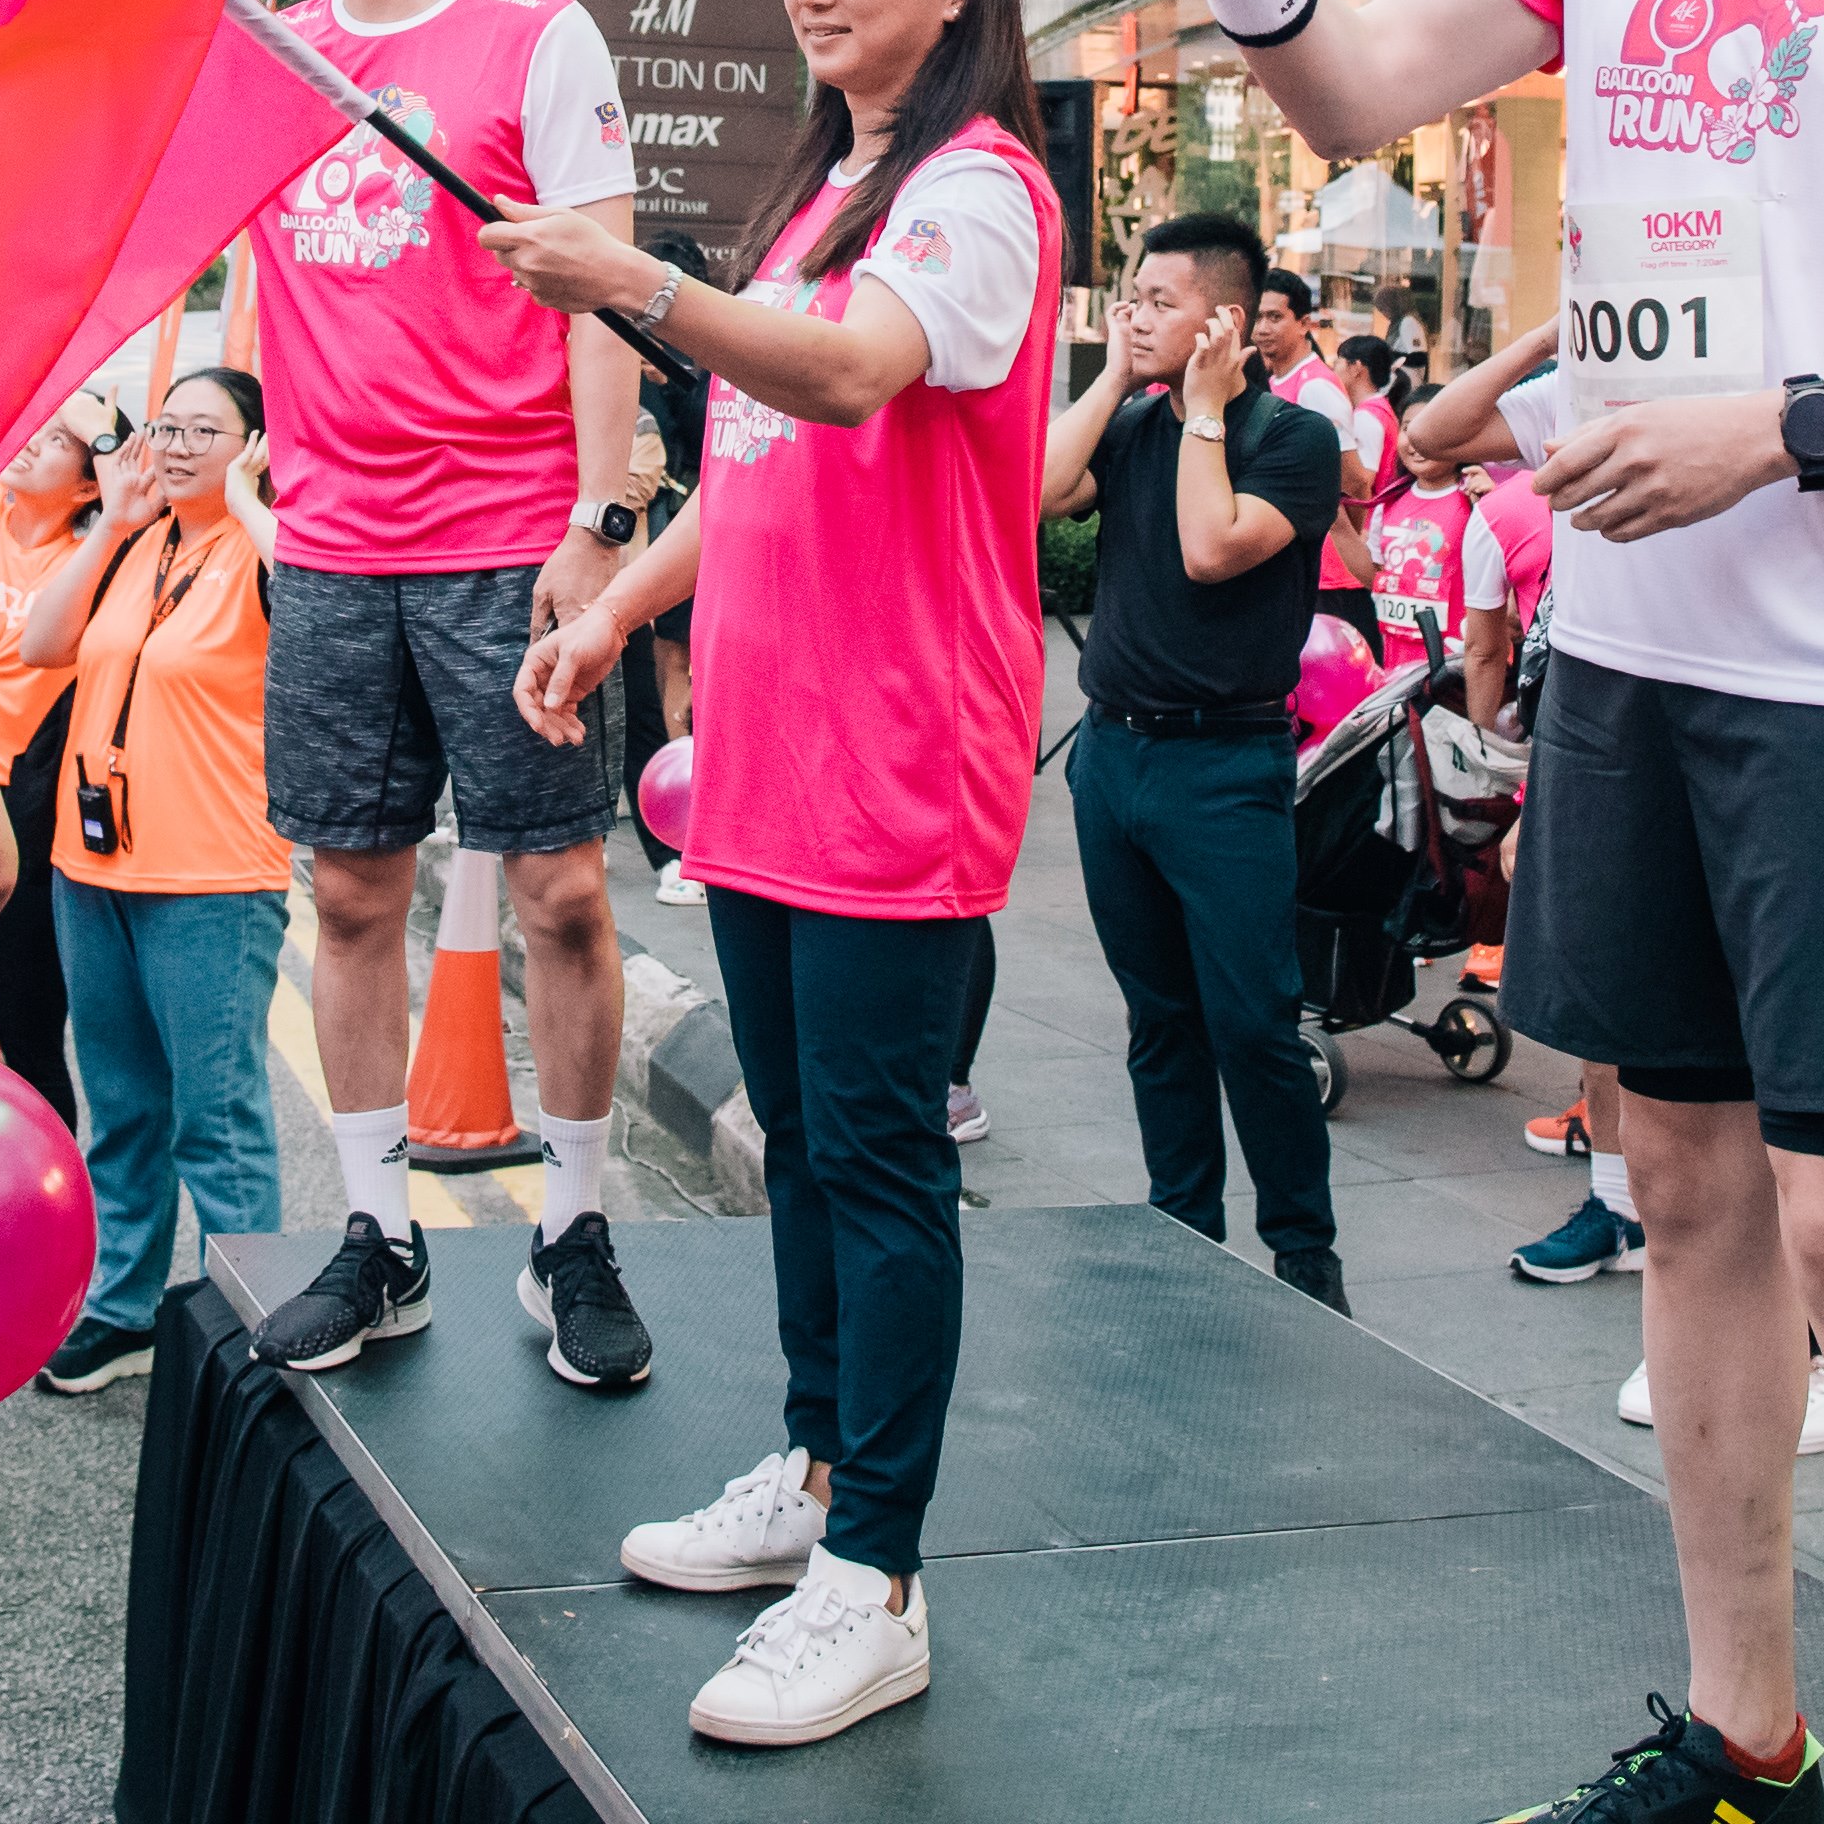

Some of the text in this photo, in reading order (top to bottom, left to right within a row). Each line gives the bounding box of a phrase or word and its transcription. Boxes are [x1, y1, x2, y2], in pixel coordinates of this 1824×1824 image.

[610, 55, 765, 94] TTON ON
[1596, 65, 1695, 98] BALLOON
[1611, 93, 1706, 148] RUN
[279, 212, 350, 233] BALLOON
[1641, 210, 1722, 240] 10KM
[294, 232, 356, 265] RUN
[1650, 239, 1718, 254] CATEGORY
